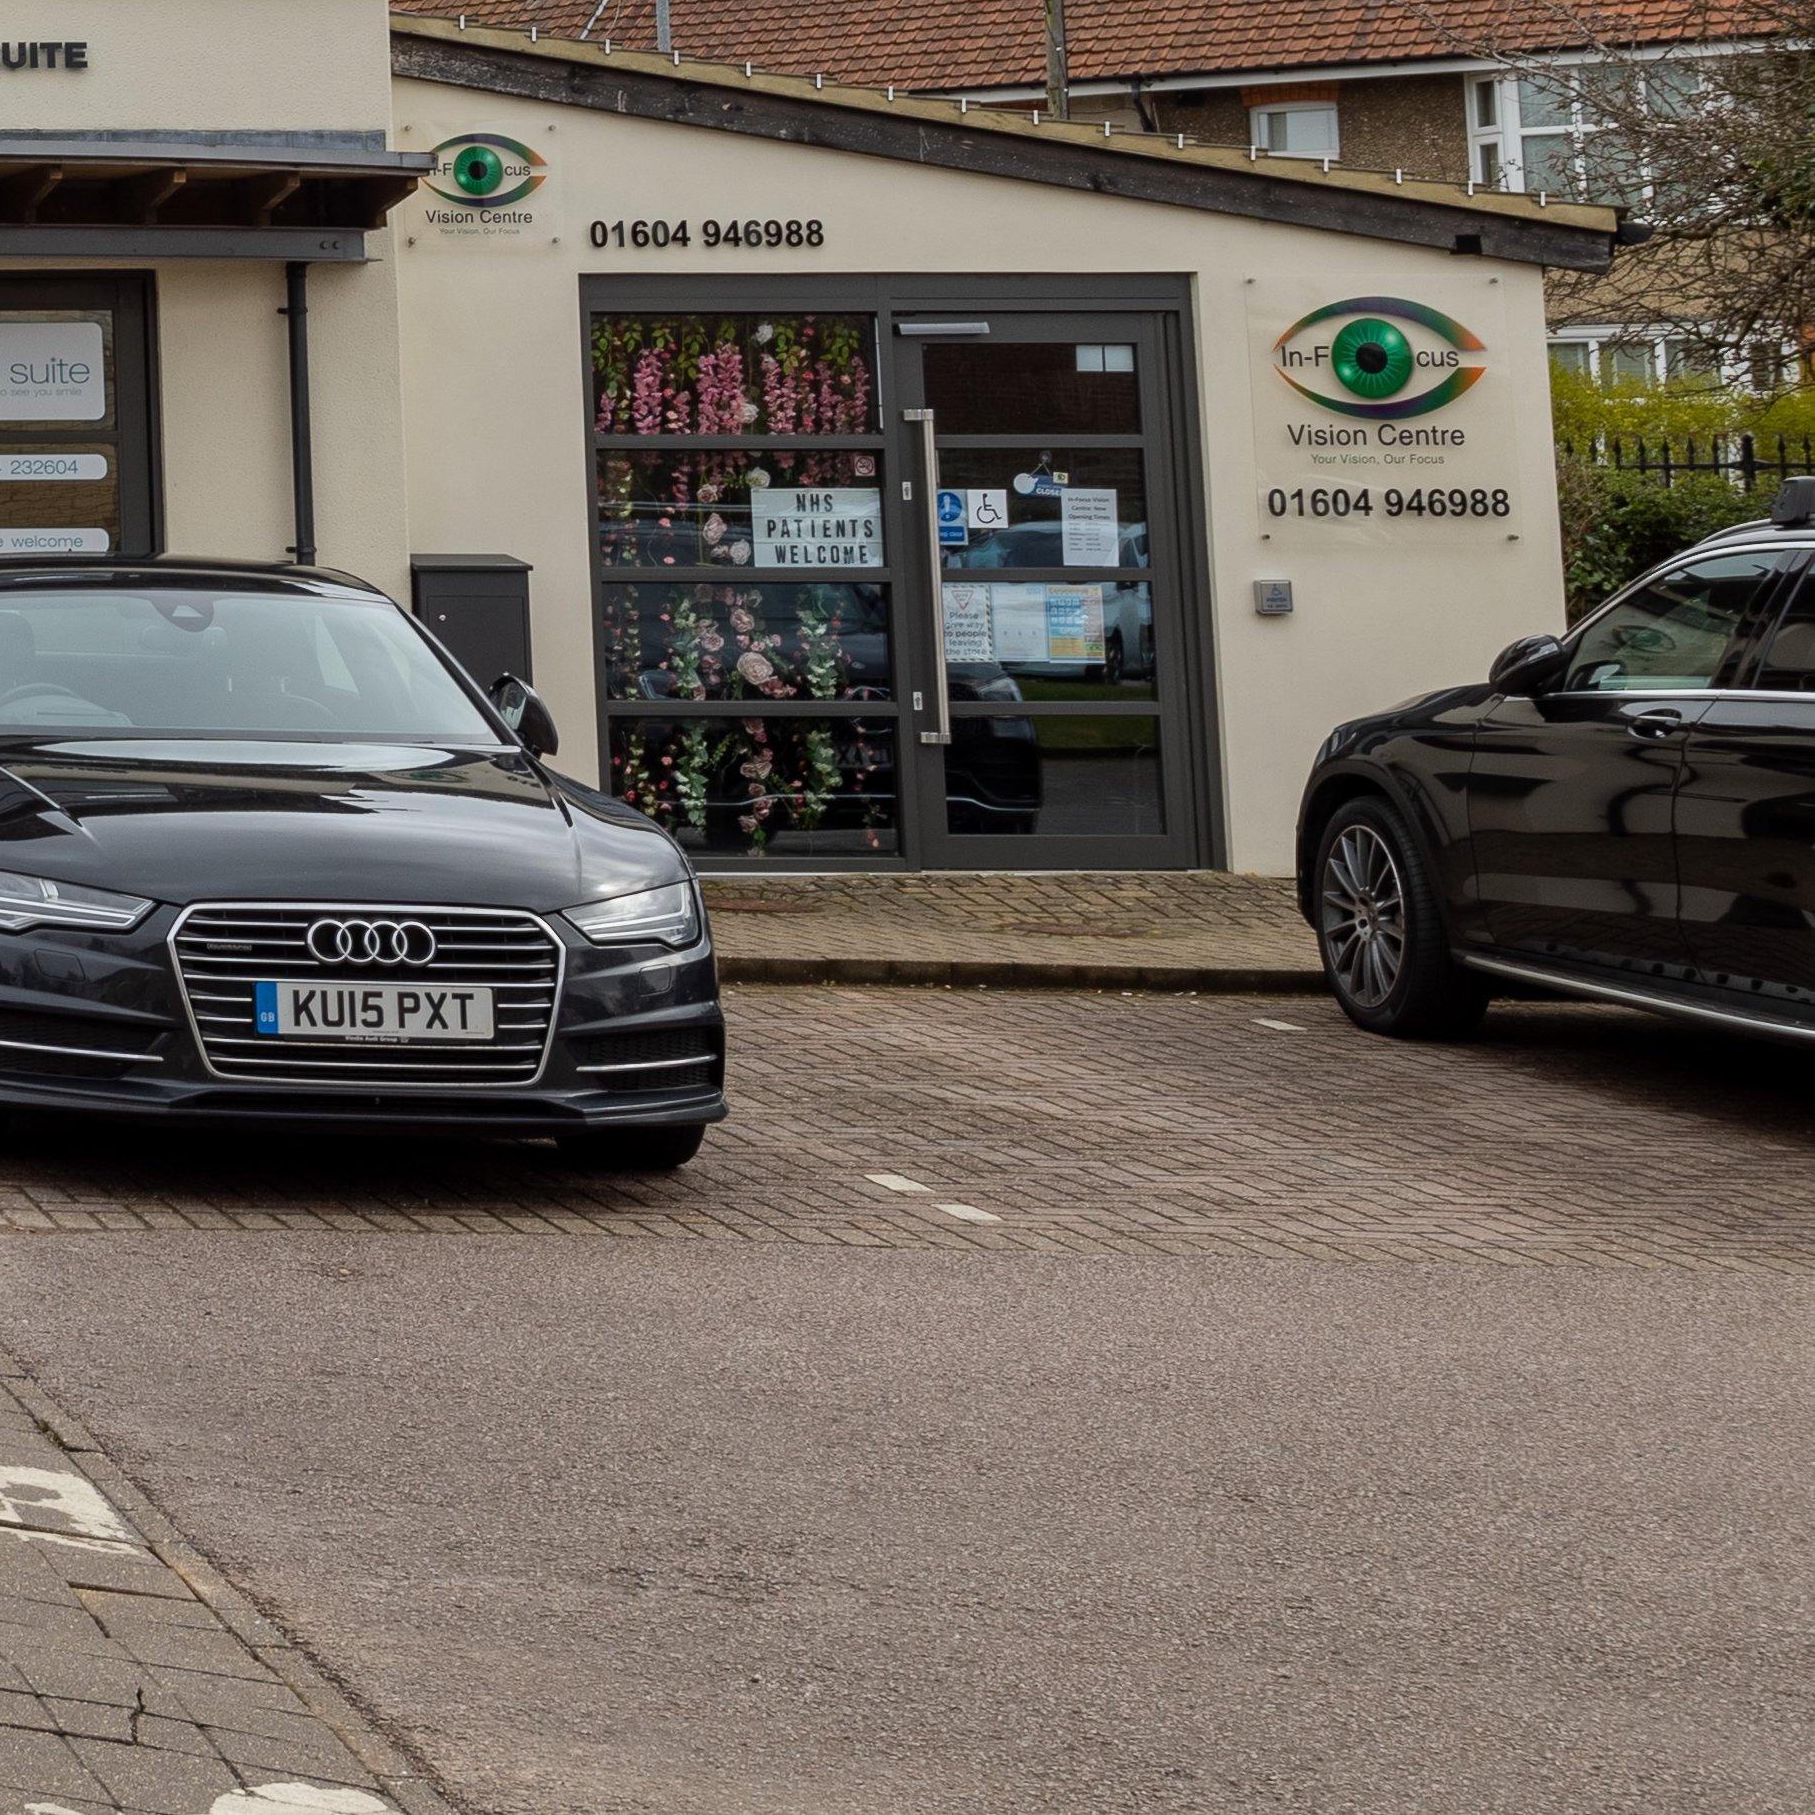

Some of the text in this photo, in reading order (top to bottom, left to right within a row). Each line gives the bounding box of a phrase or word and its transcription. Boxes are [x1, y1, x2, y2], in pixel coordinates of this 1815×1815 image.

[425, 208, 532, 223] Vision Centre
[439, 226, 455, 234] Your
[482, 226, 496, 234] Our
[498, 226, 520, 234] Focus
[589, 218, 824, 248] 01604 946988
[9, 356, 89, 384] suite
[10, 388, 29, 396] see
[33, 388, 52, 397] you
[1286, 422, 1465, 445] Vision Centre
[10, 459, 78, 474] 232604
[1310, 452, 1445, 465] Your Vision, Our Focus
[795, 492, 833, 512] NHS
[1267, 487, 1510, 517] 01604 946988
[766, 518, 873, 537] PATIENTS
[11, 534, 83, 547] welcome
[774, 543, 867, 564] WELCOME
[949, 610, 978, 620] Please
[260, 1011, 274, 1022] GB
[292, 988, 474, 1030] KU15 PXT
